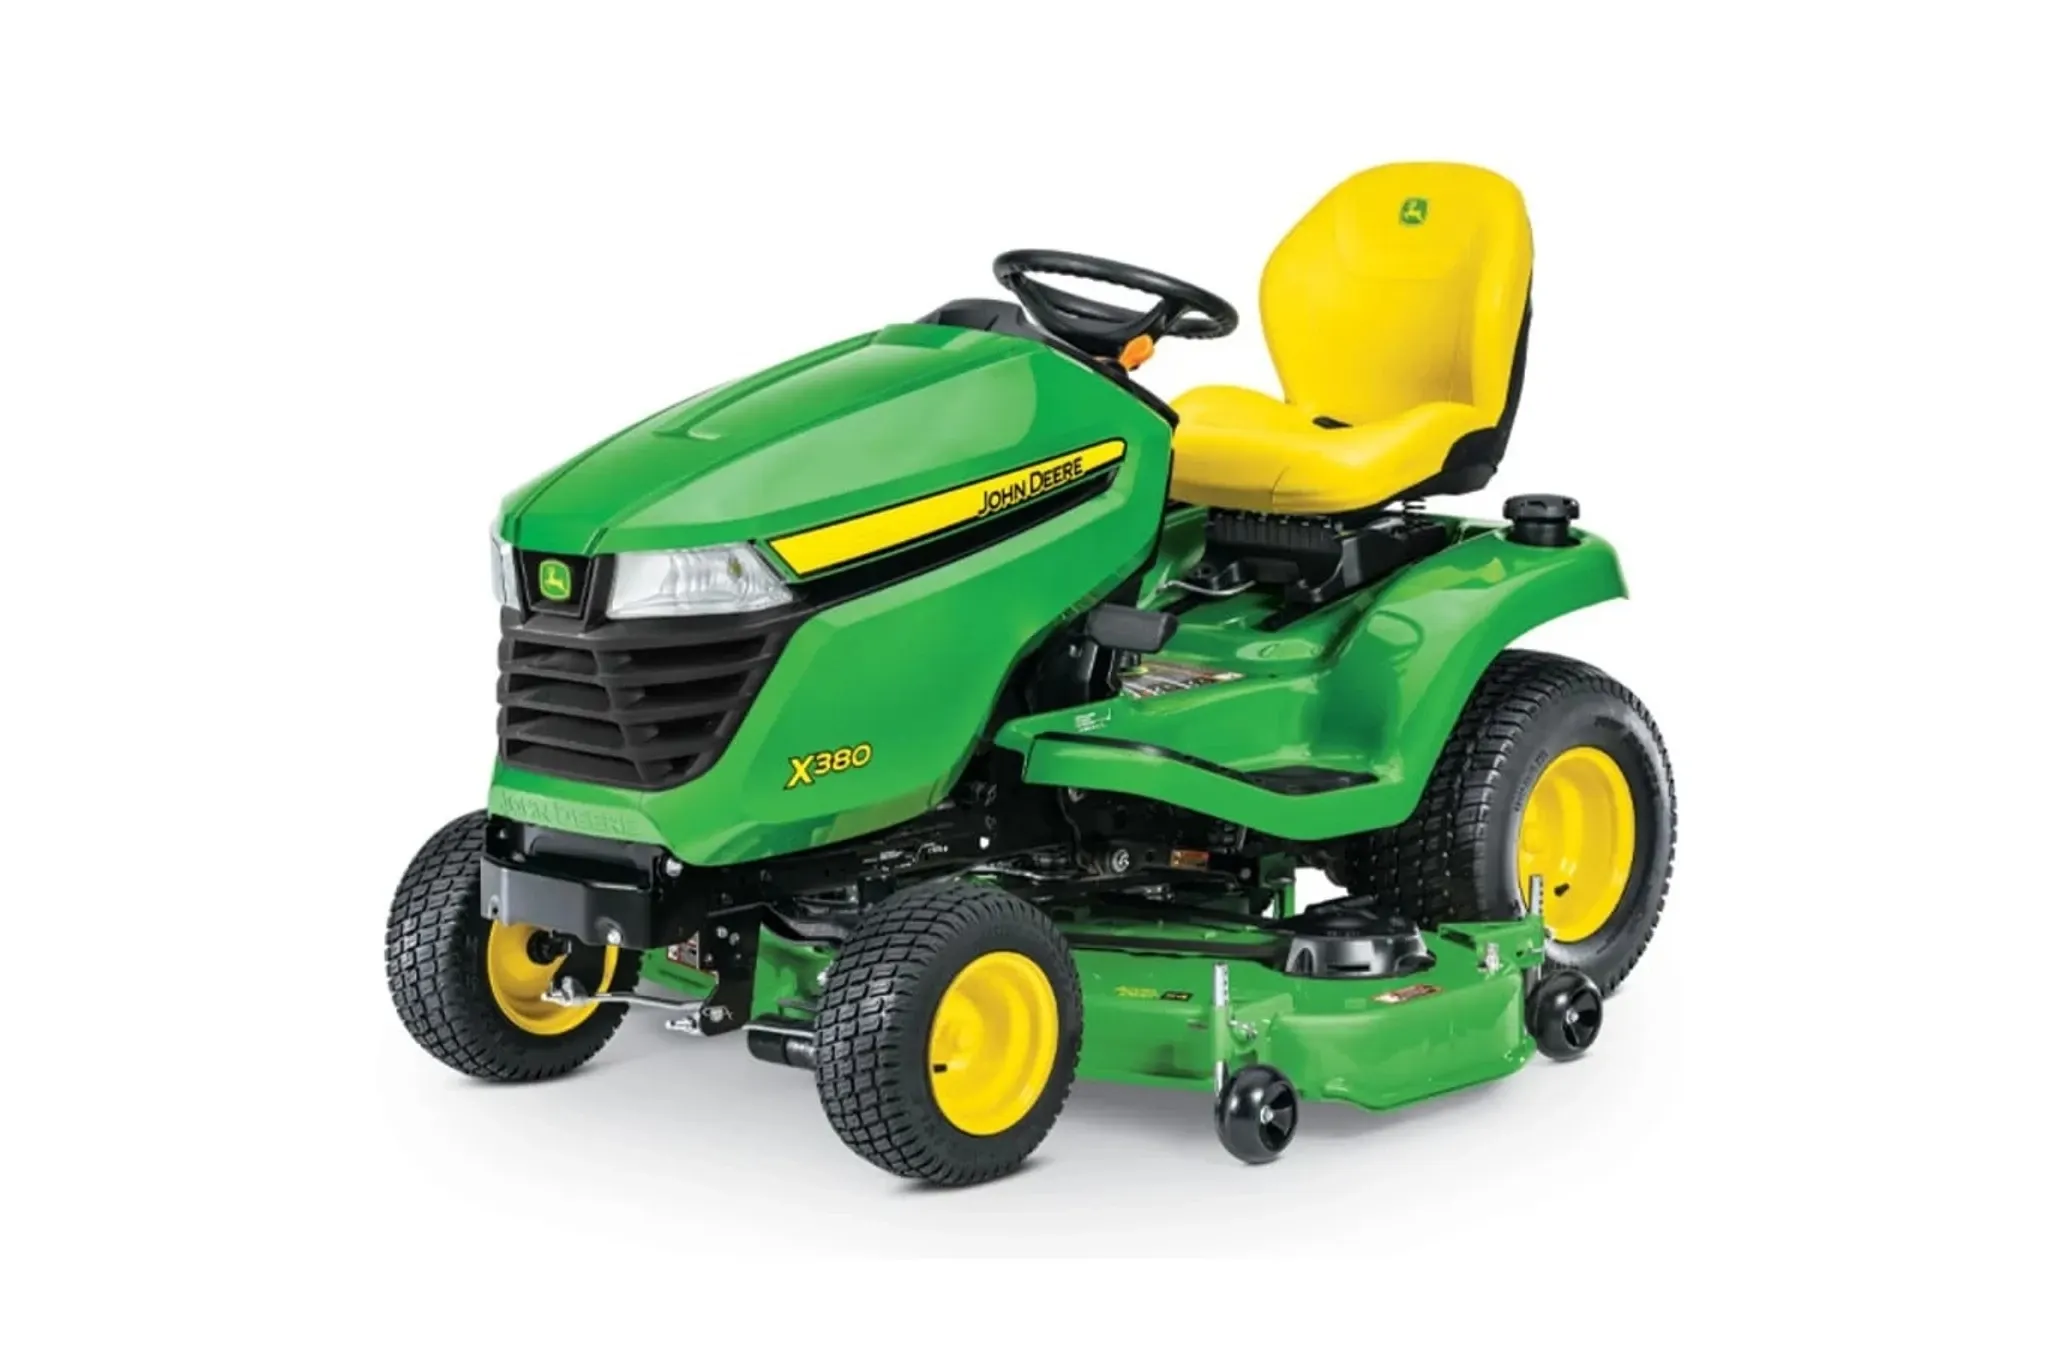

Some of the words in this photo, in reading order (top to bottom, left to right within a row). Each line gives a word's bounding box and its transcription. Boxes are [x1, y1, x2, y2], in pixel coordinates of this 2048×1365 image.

[978, 479, 1026, 515] JOHN
[1029, 457, 1083, 494] DEERE
[783, 742, 873, 790] X380
